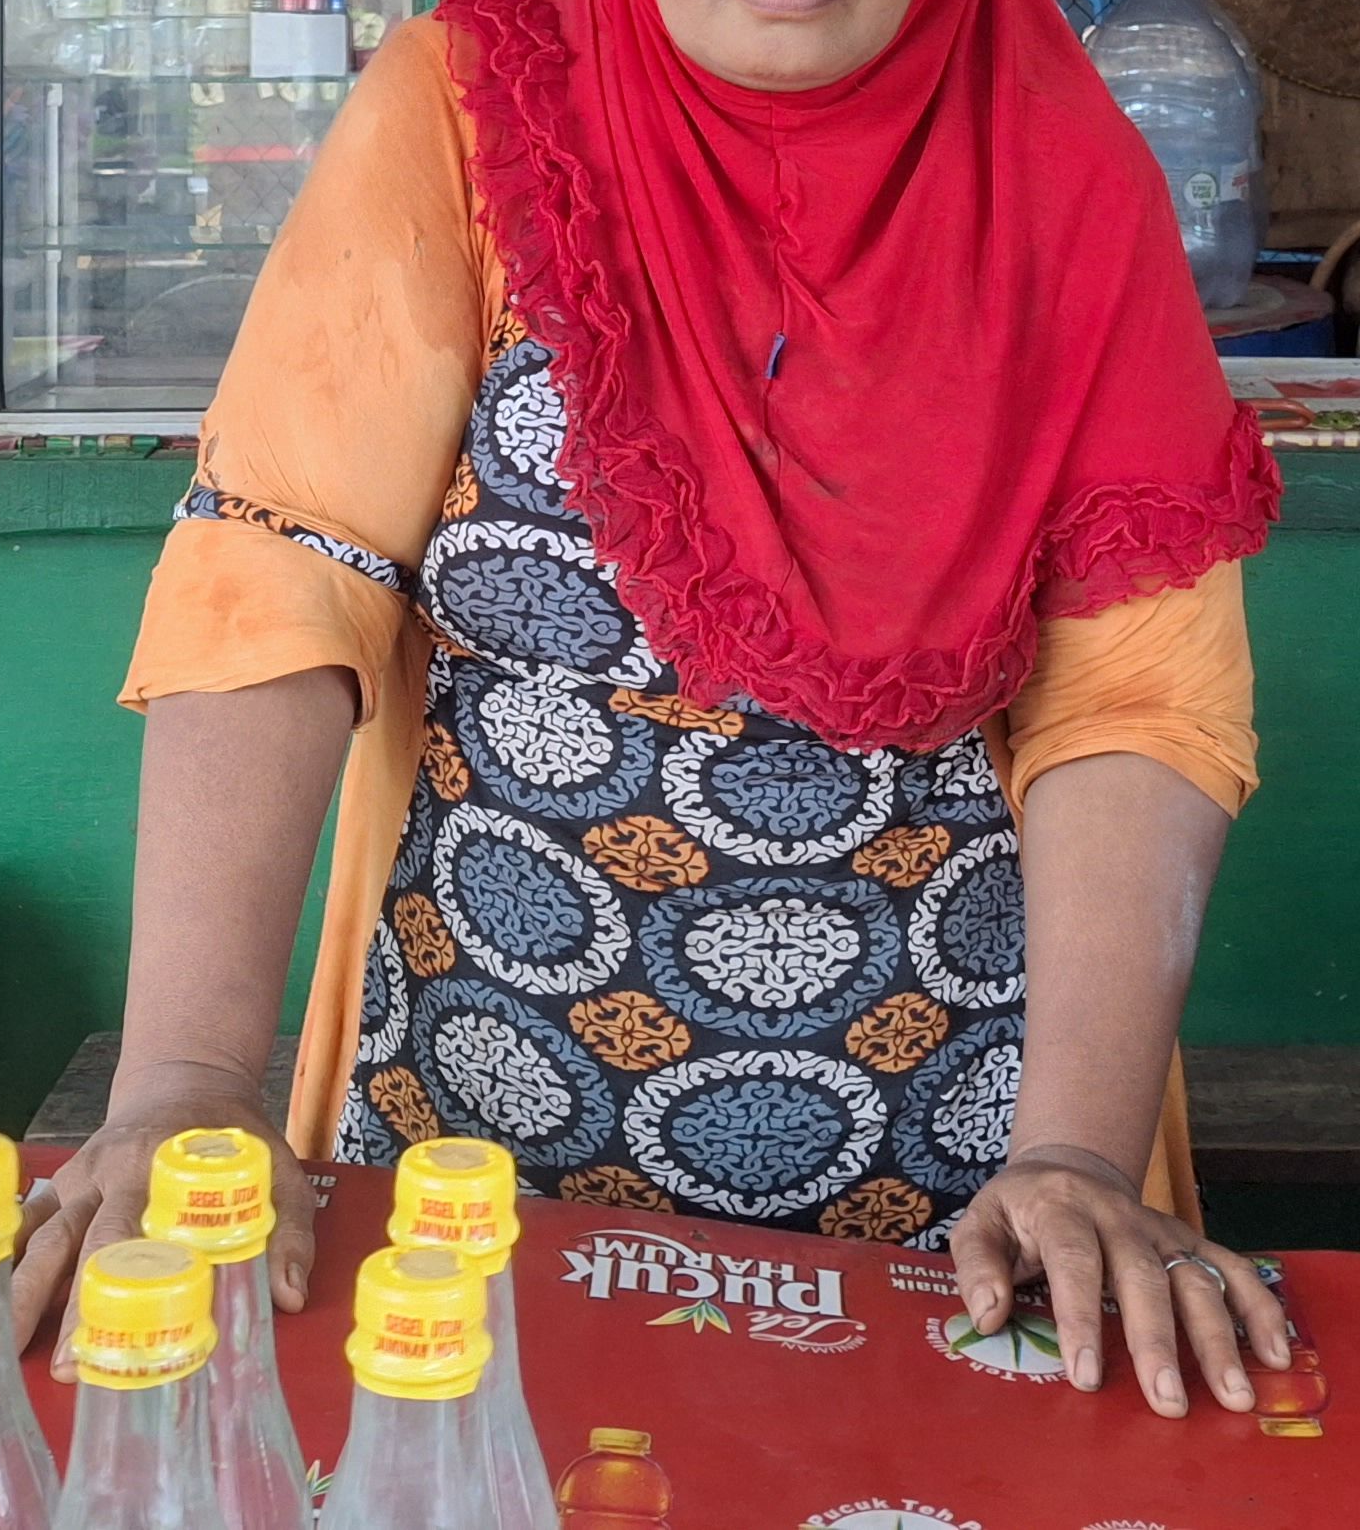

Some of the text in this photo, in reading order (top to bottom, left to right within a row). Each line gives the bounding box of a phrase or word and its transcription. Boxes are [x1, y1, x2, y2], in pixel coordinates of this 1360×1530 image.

[187, 1190, 226, 1207] SEGEL
[176, 1211, 232, 1228] JAMINAN
[593, 1234, 796, 1283] HARUM
[891, 1277, 961, 1296] rbaik
[87, 1322, 195, 1349] SEGEL UTUH
[746, 1310, 867, 1347] Teh
[781, 1335, 867, 1354] MINUMAN
[969, 1361, 1017, 1383] Teh
[807, 1497, 955, 1527] Pucuk Teh
